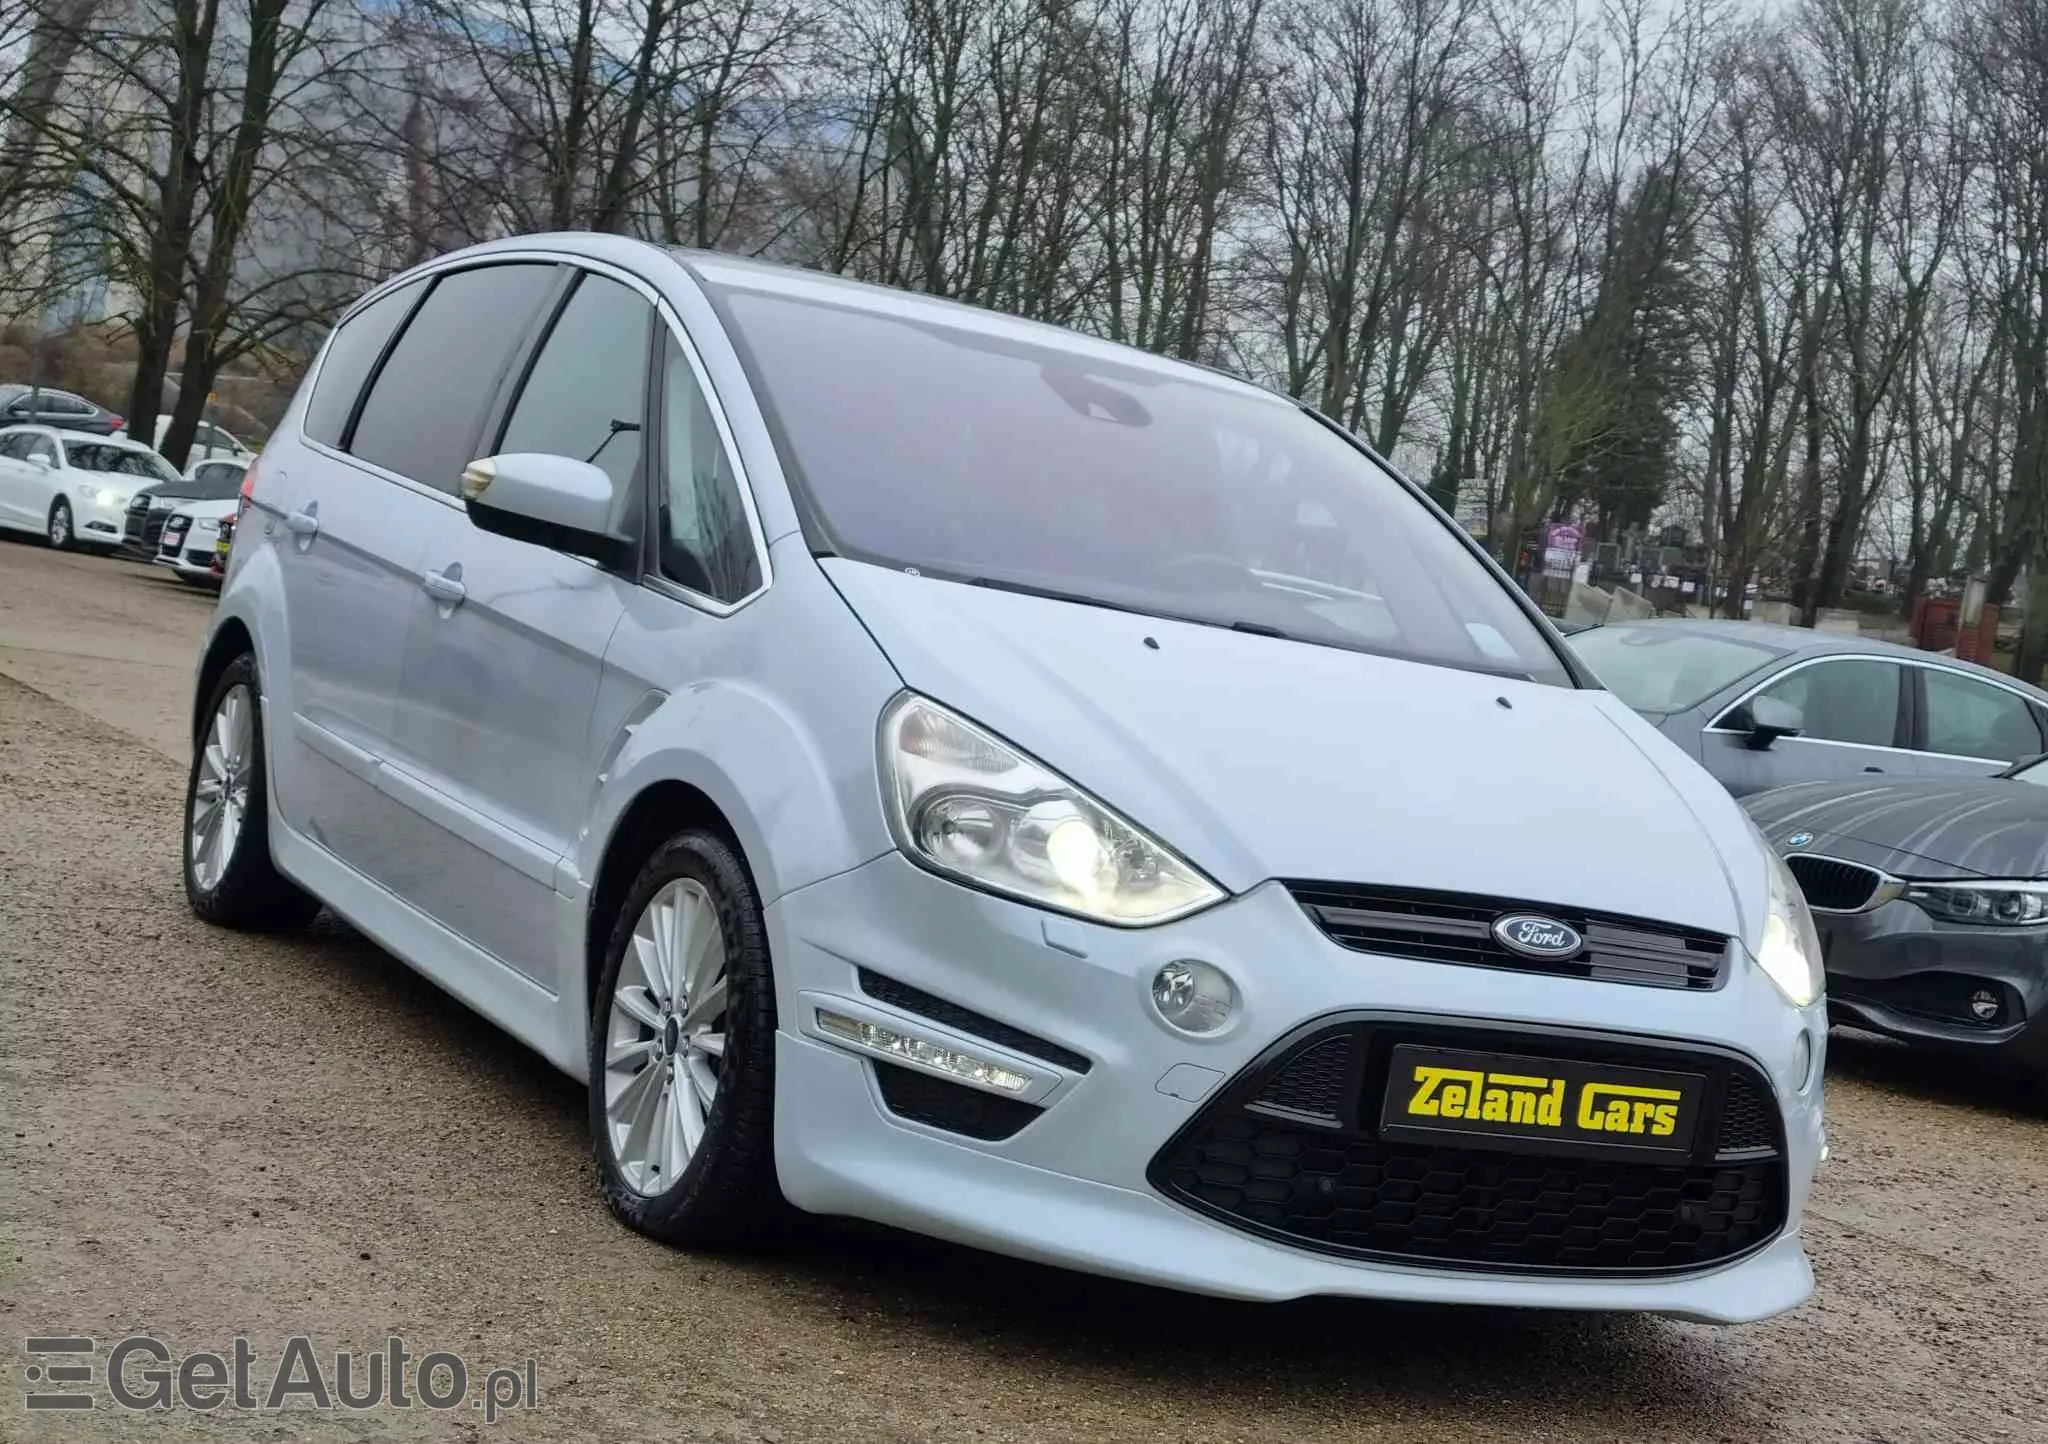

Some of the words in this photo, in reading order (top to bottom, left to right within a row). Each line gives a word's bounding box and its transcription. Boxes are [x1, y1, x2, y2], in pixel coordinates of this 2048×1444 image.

[1518, 920, 1566, 947] Ford
[1409, 1067, 1566, 1126] Zeland
[1578, 1083, 1681, 1136] Cars
